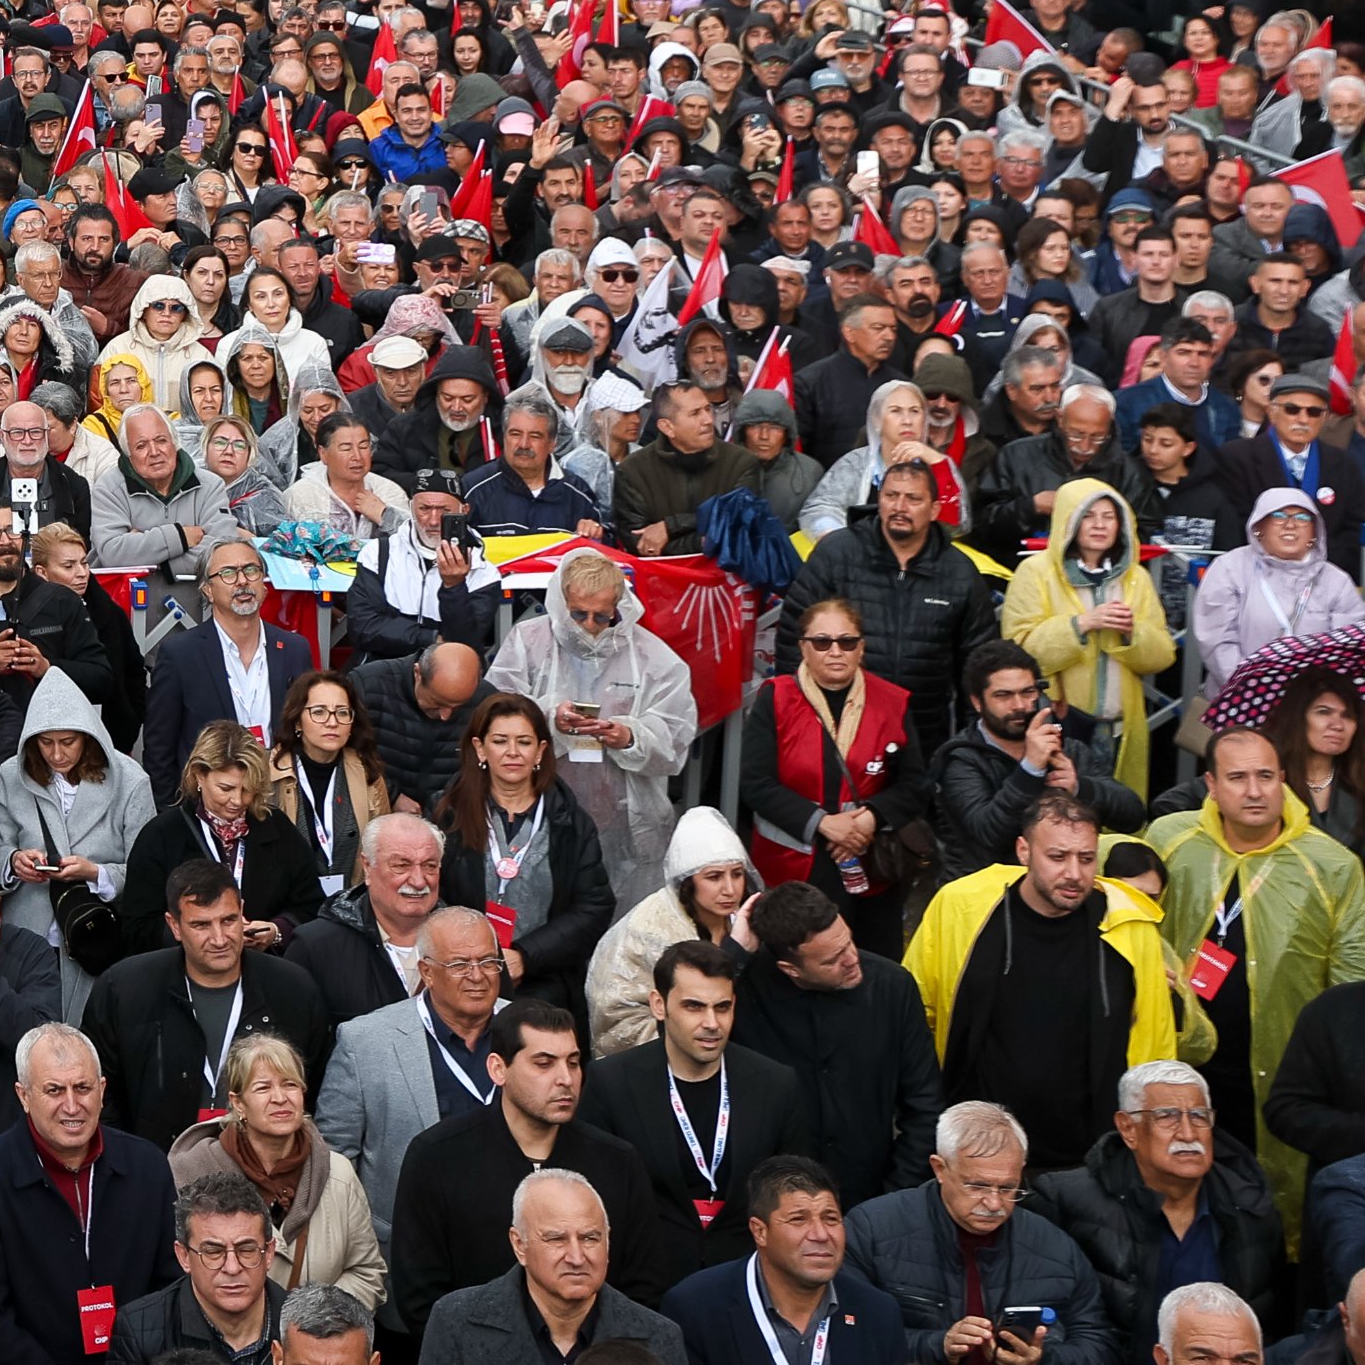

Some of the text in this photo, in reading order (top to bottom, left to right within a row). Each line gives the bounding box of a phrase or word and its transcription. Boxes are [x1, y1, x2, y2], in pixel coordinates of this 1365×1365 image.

[485, 912, 513, 926] PROTOKOL
[81, 1302, 113, 1313] PROTOKOL
[95, 1336, 109, 1345] CHP
